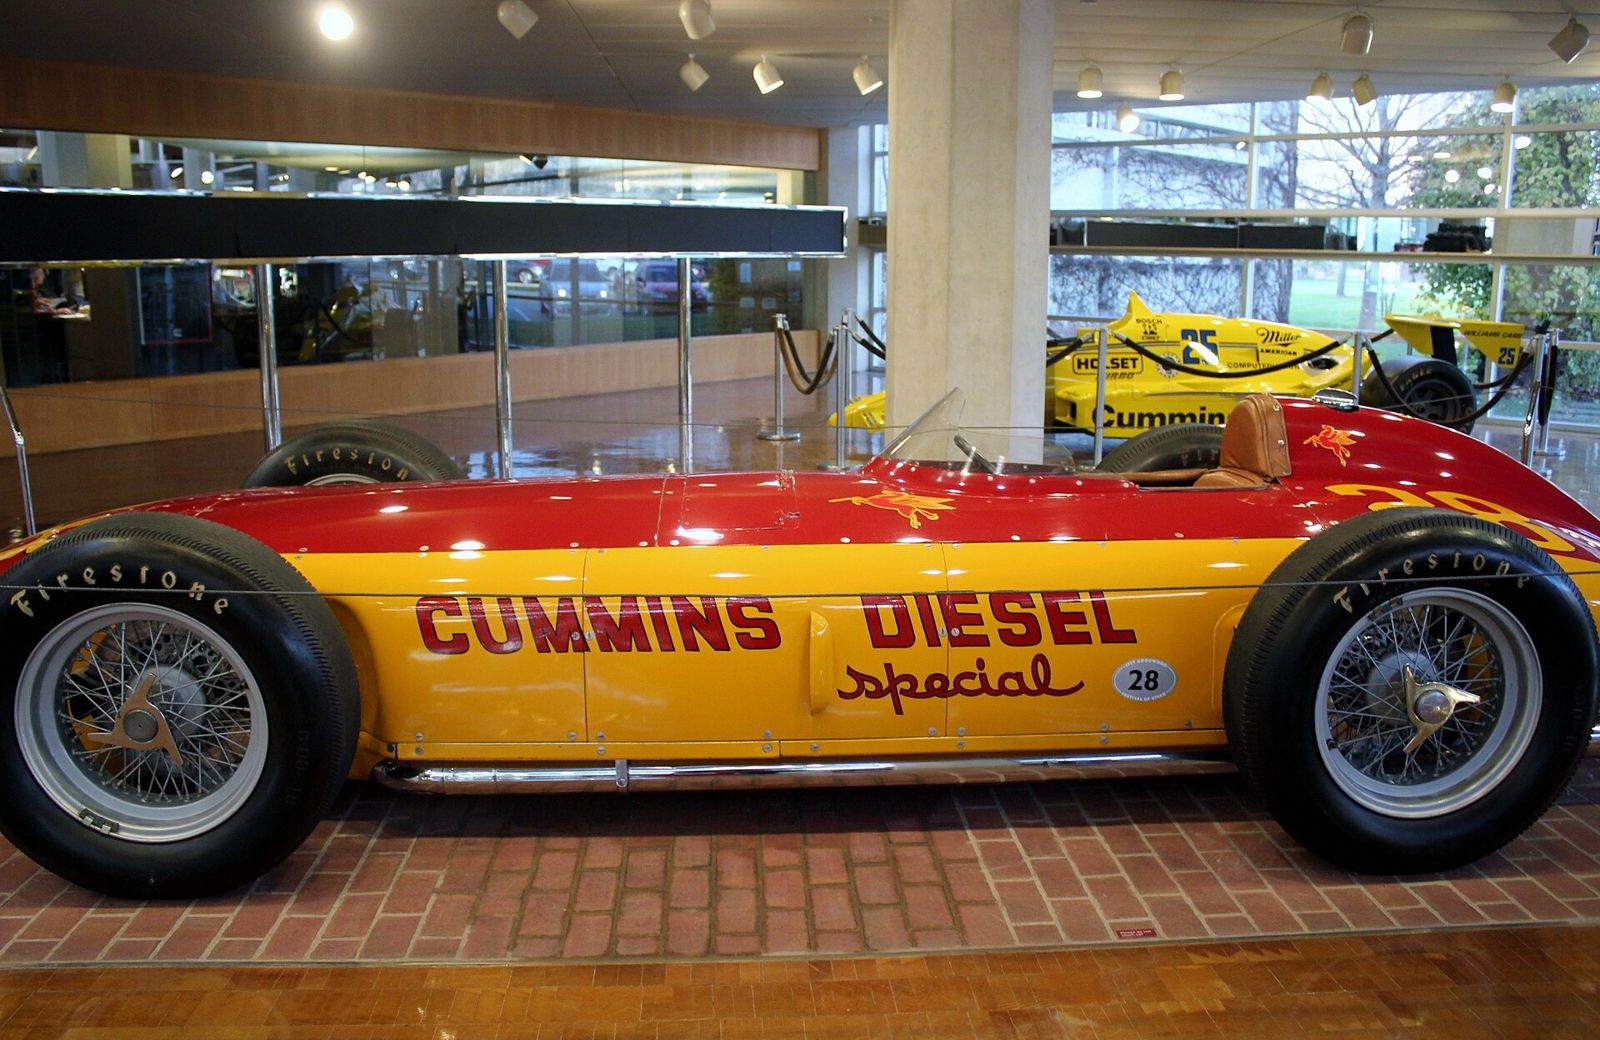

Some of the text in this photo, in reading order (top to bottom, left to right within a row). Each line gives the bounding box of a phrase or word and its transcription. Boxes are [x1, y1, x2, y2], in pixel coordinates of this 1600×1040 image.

[1181, 329, 1219, 364] 25
[1256, 327, 1302, 345] Miller
[1077, 358, 1139, 369] HOSET
[1259, 348, 1298, 356] AMERICAN
[1498, 347, 1516, 365] 25
[1092, 404, 1226, 427] Cummin
[284, 447, 409, 480] Fireston
[10, 564, 229, 618] Firestone
[1333, 552, 1530, 613] Firestone
[415, 591, 1138, 655] CUMMINS DIESEL
[836, 653, 1085, 716] special
[1128, 669, 1159, 691] 28
